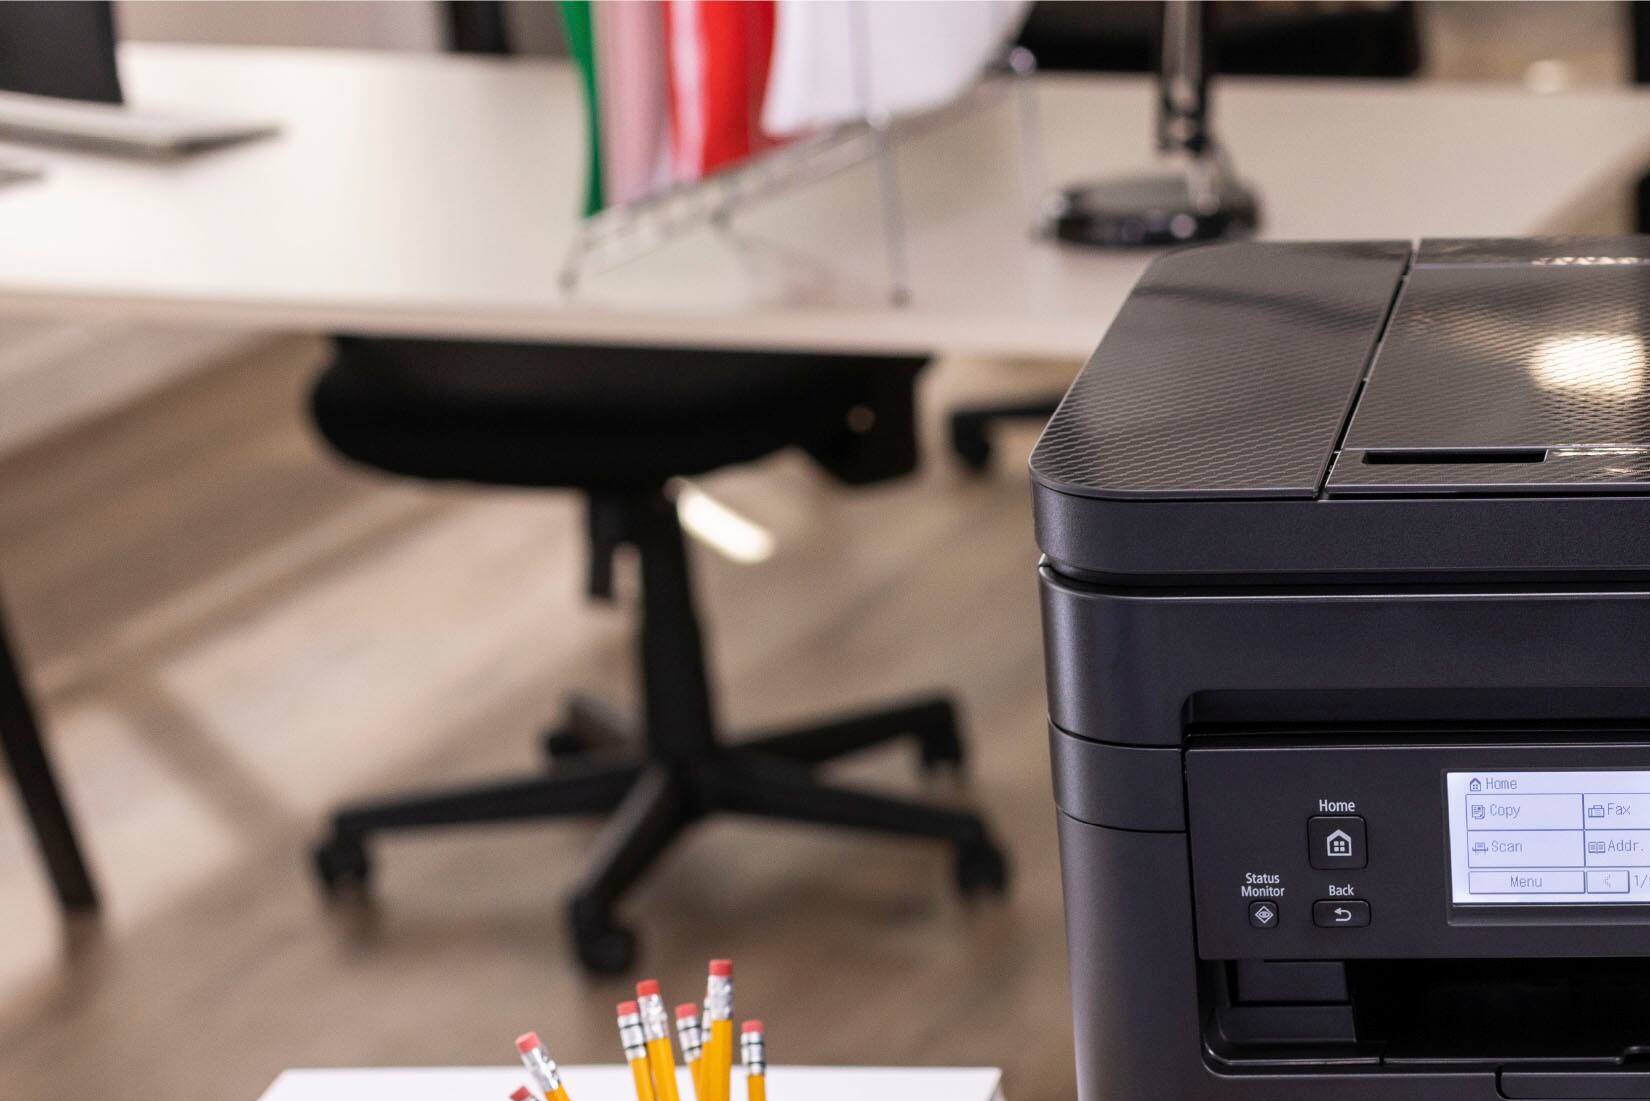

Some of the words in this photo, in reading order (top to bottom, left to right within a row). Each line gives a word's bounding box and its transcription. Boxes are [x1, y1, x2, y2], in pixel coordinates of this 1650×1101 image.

[1485, 777, 1518, 790] Home
[1318, 799, 1356, 812] Home
[1489, 803, 1521, 820] Copy
[1607, 802, 1631, 816] Fax
[1491, 839, 1523, 853] Scan
[1607, 839, 1644, 852] Addr.
[1245, 872, 1280, 884] Status
[1510, 875, 1543, 889] Menu
[1241, 885, 1285, 897] Monitor
[1328, 883, 1355, 896] Back
